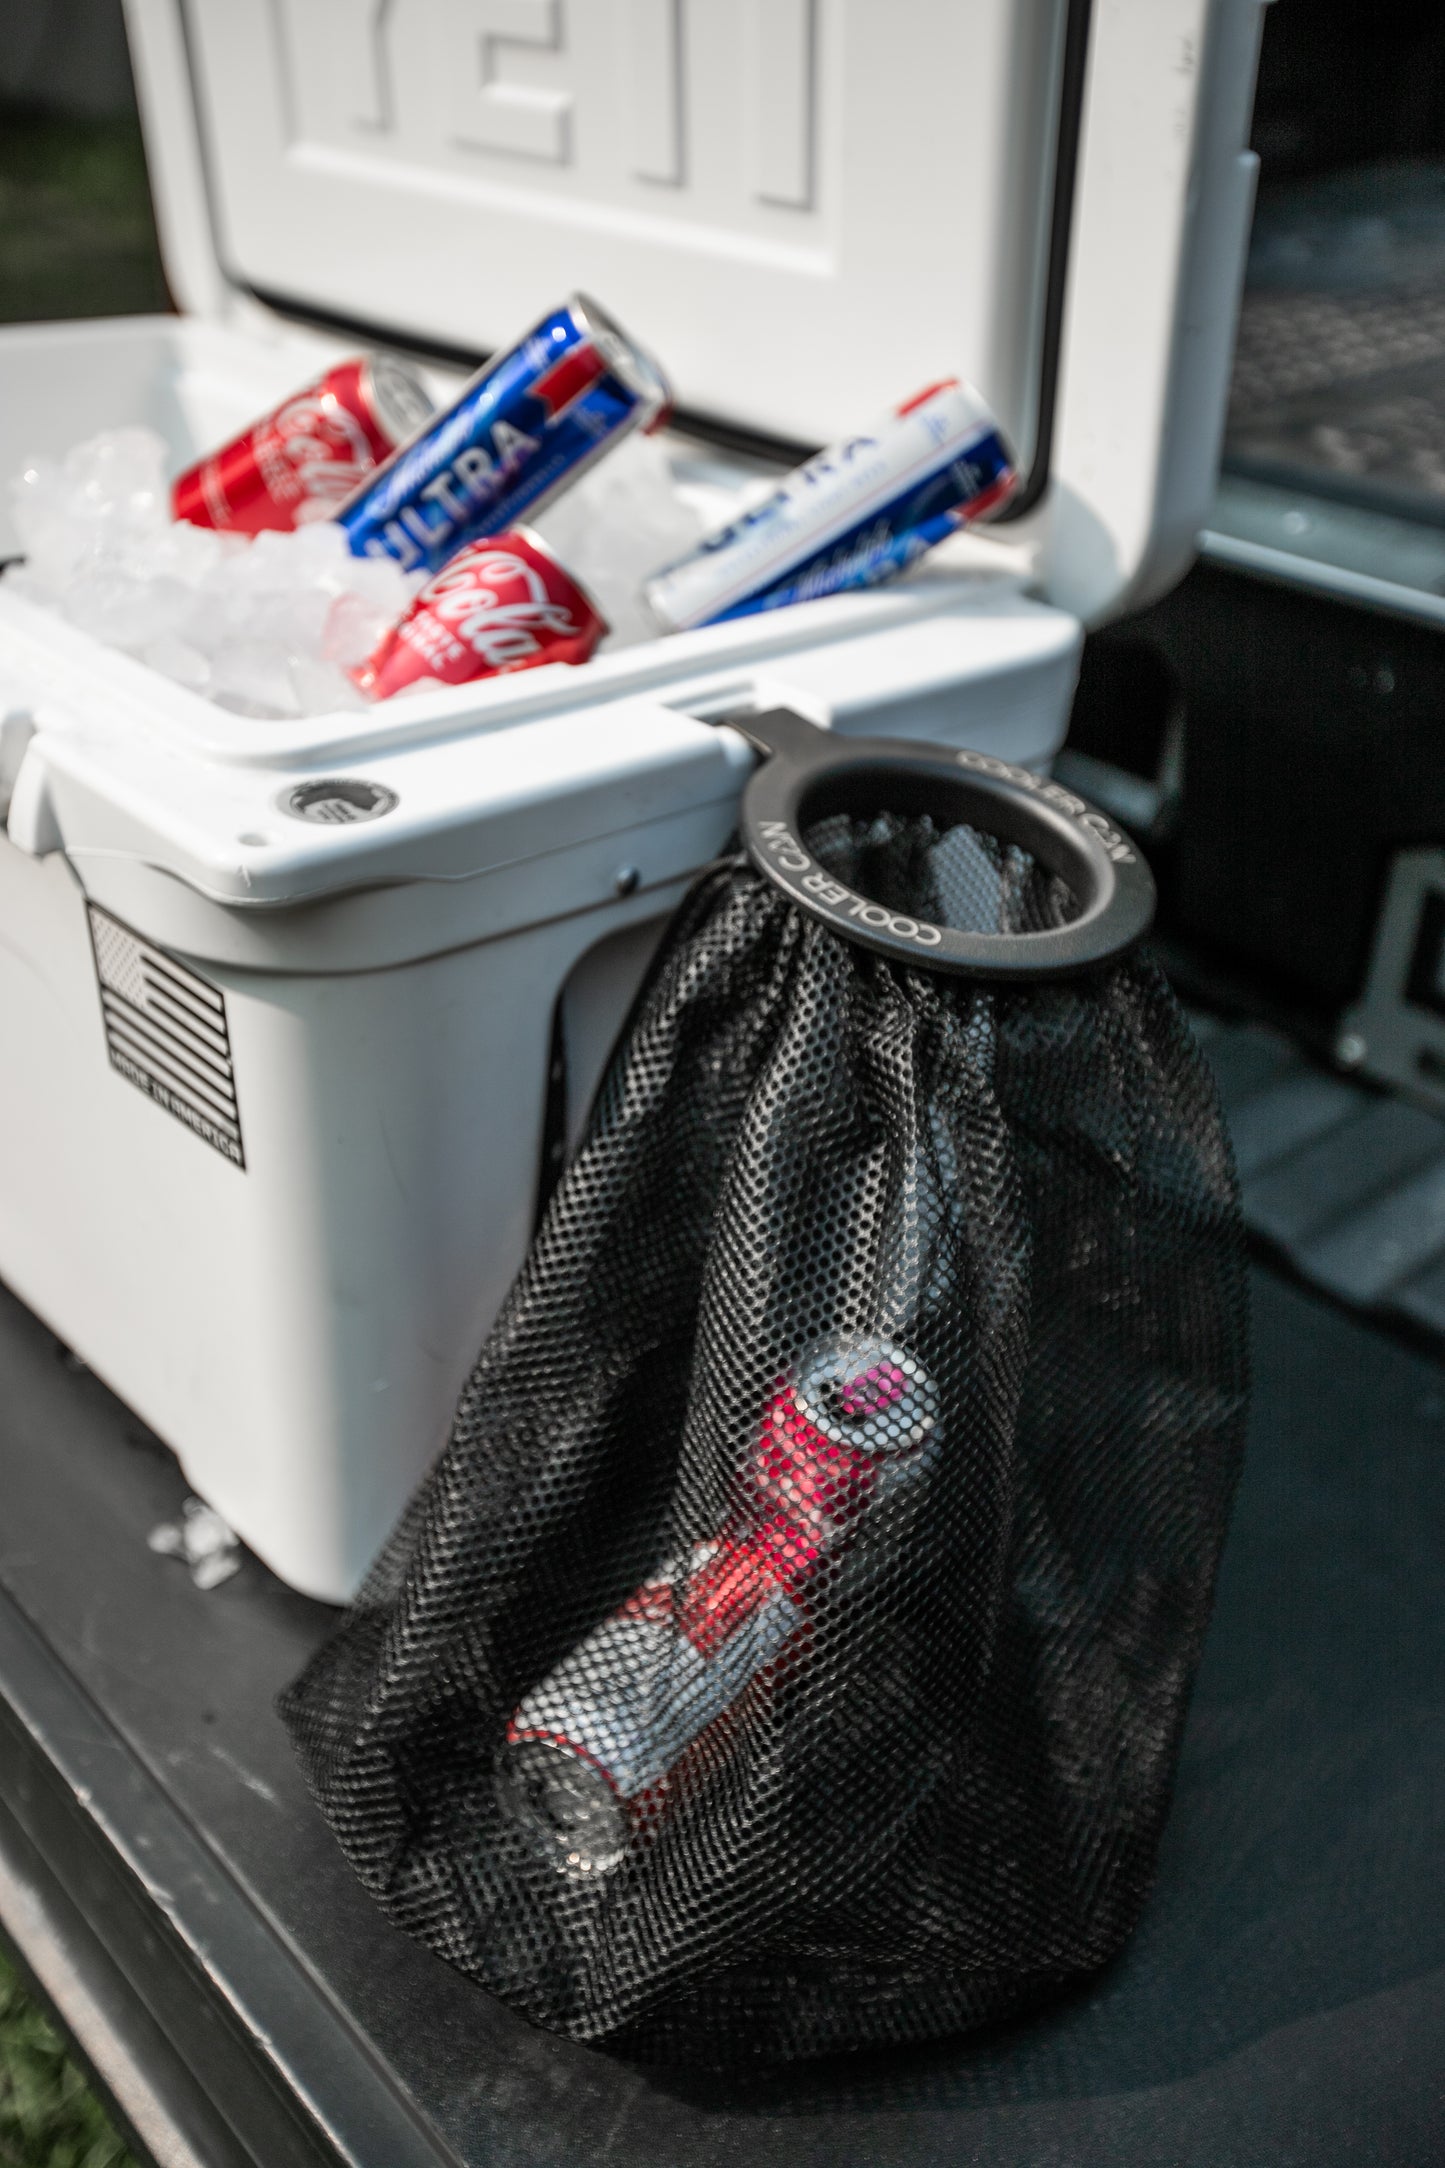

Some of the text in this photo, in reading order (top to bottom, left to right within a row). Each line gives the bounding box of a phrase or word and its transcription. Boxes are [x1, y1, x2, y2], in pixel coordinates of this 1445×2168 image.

[363, 419, 541, 571] ULTRA
[757, 820, 942, 946] COOLER CAN
